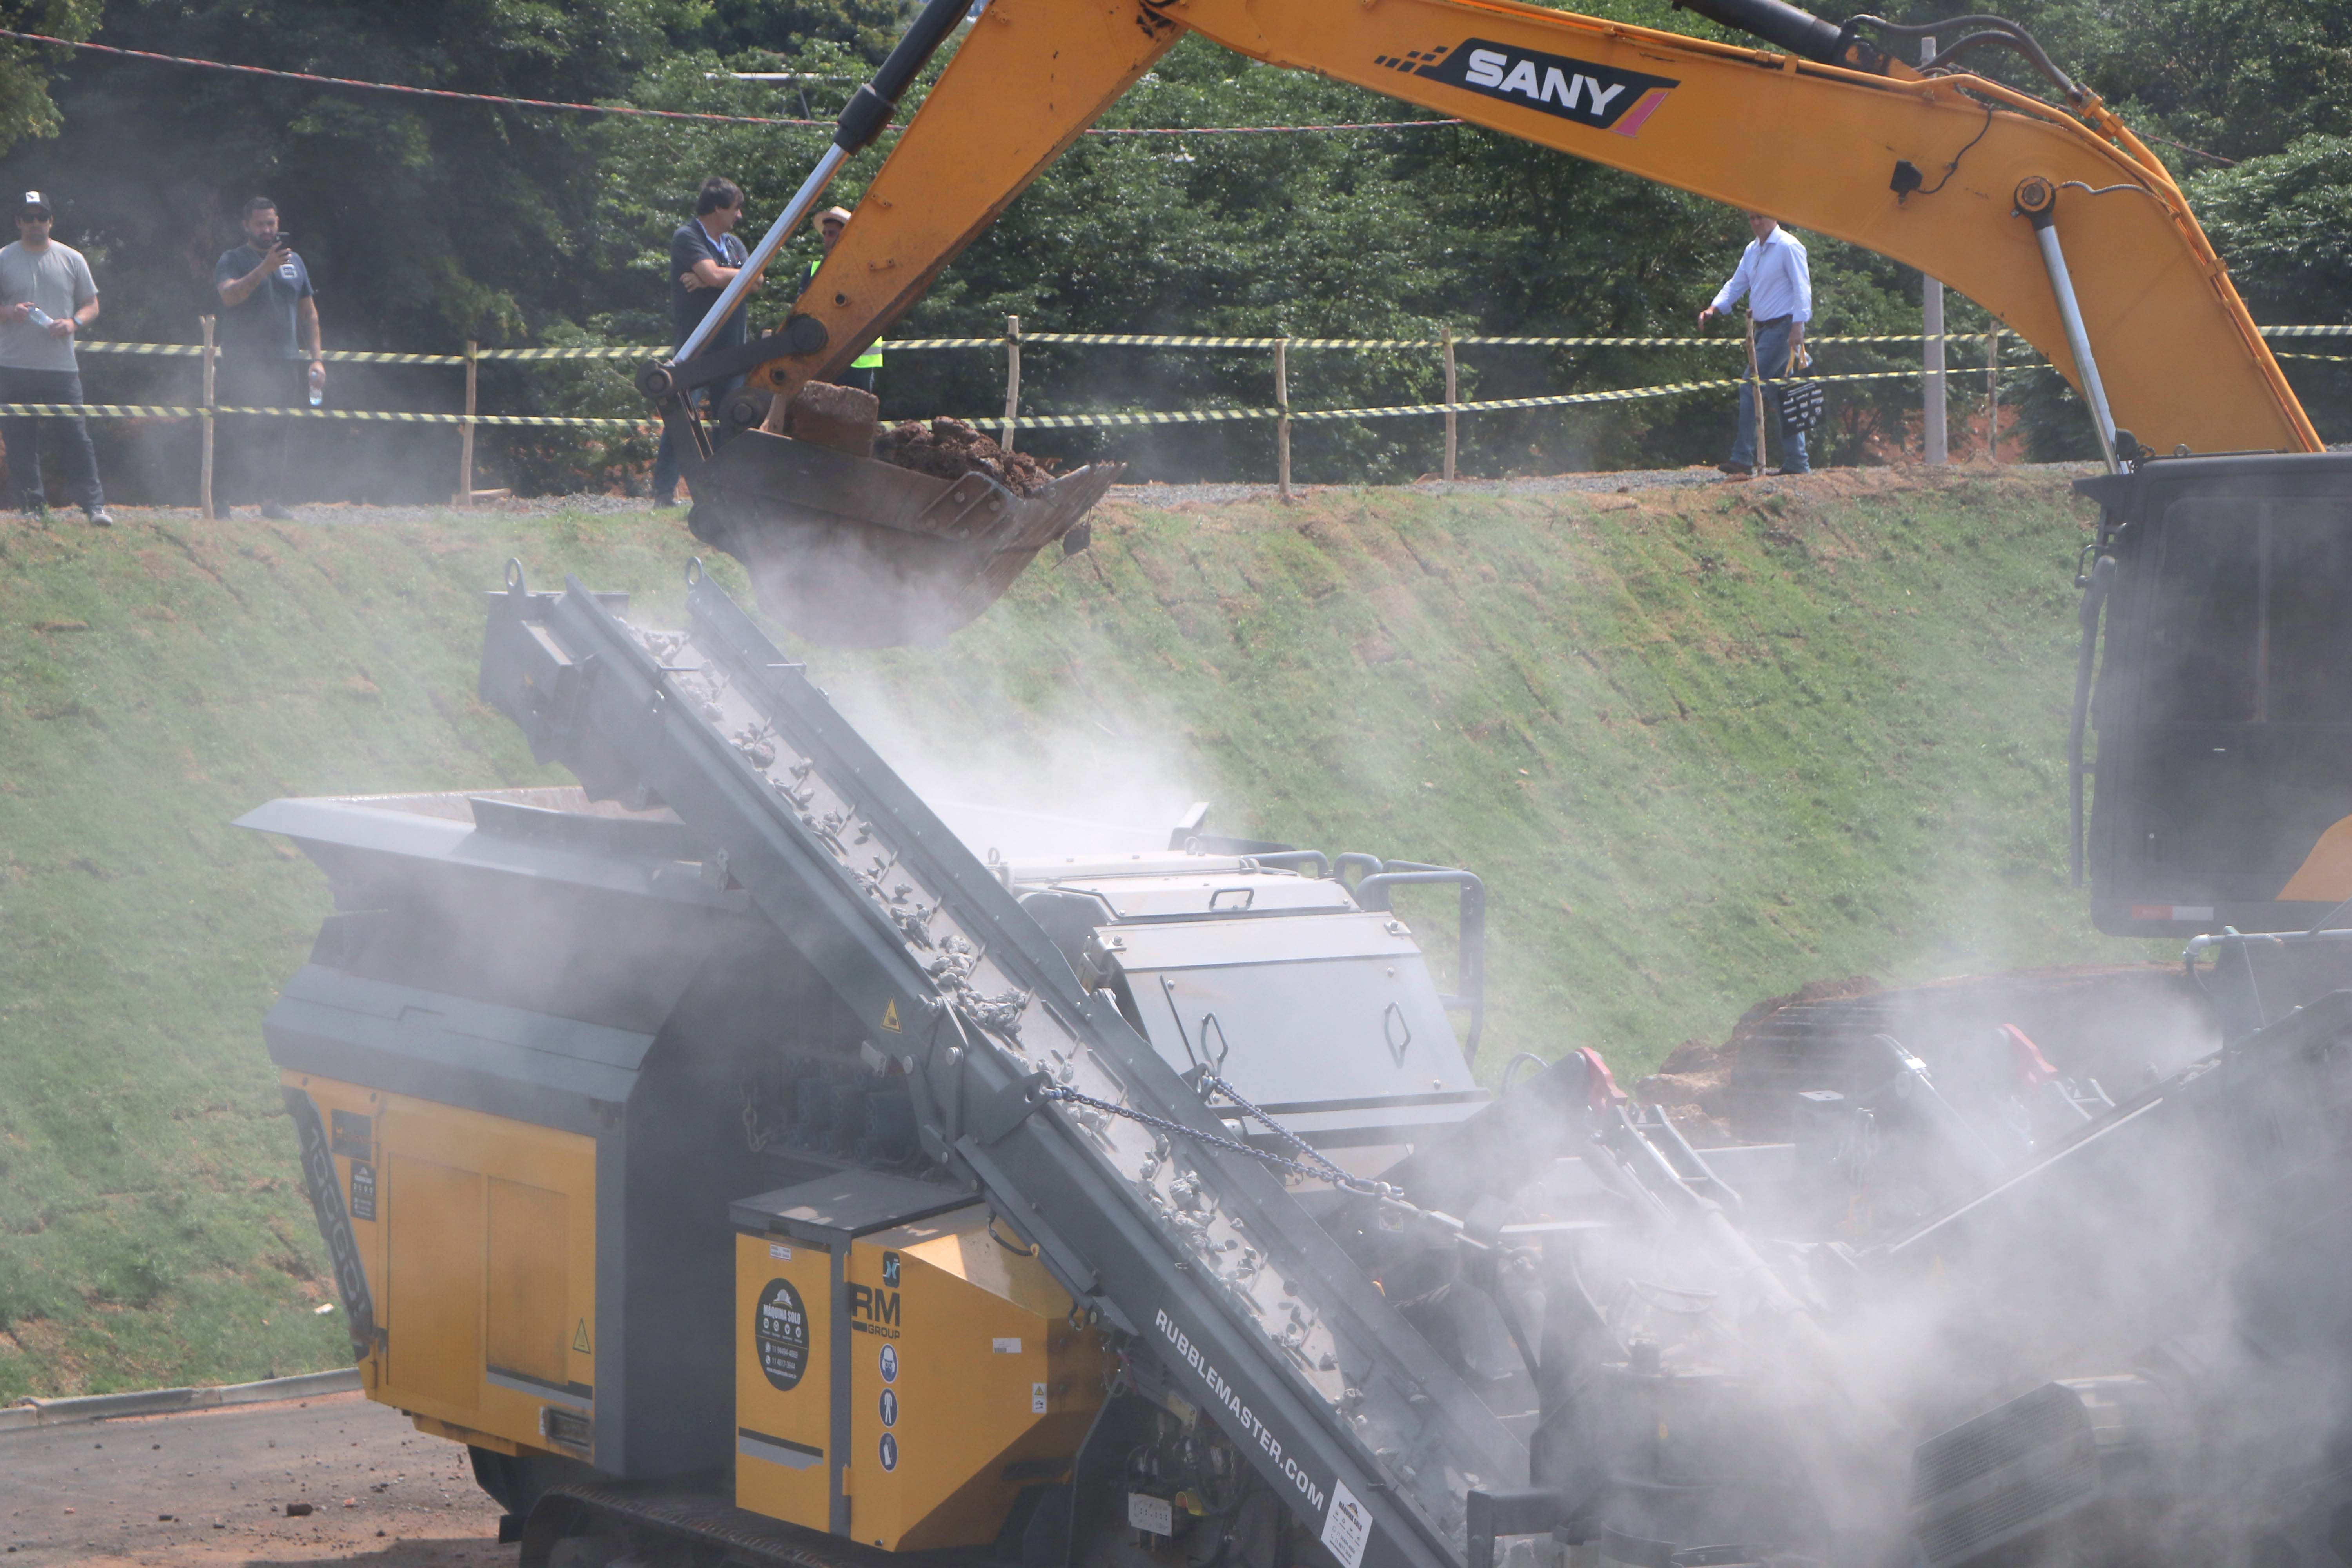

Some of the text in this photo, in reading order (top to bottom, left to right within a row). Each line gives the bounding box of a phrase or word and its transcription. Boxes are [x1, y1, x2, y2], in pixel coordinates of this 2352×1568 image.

[1465, 49, 1625, 116] SANY
[787, 1310, 801, 1325] SOLO
[849, 1283, 900, 1327] RM
[868, 1324, 900, 1339] GROUP
[1155, 1308, 1324, 1511] RUBBLEMASTER.COM
[1353, 1518, 1363, 1532] SOLO
